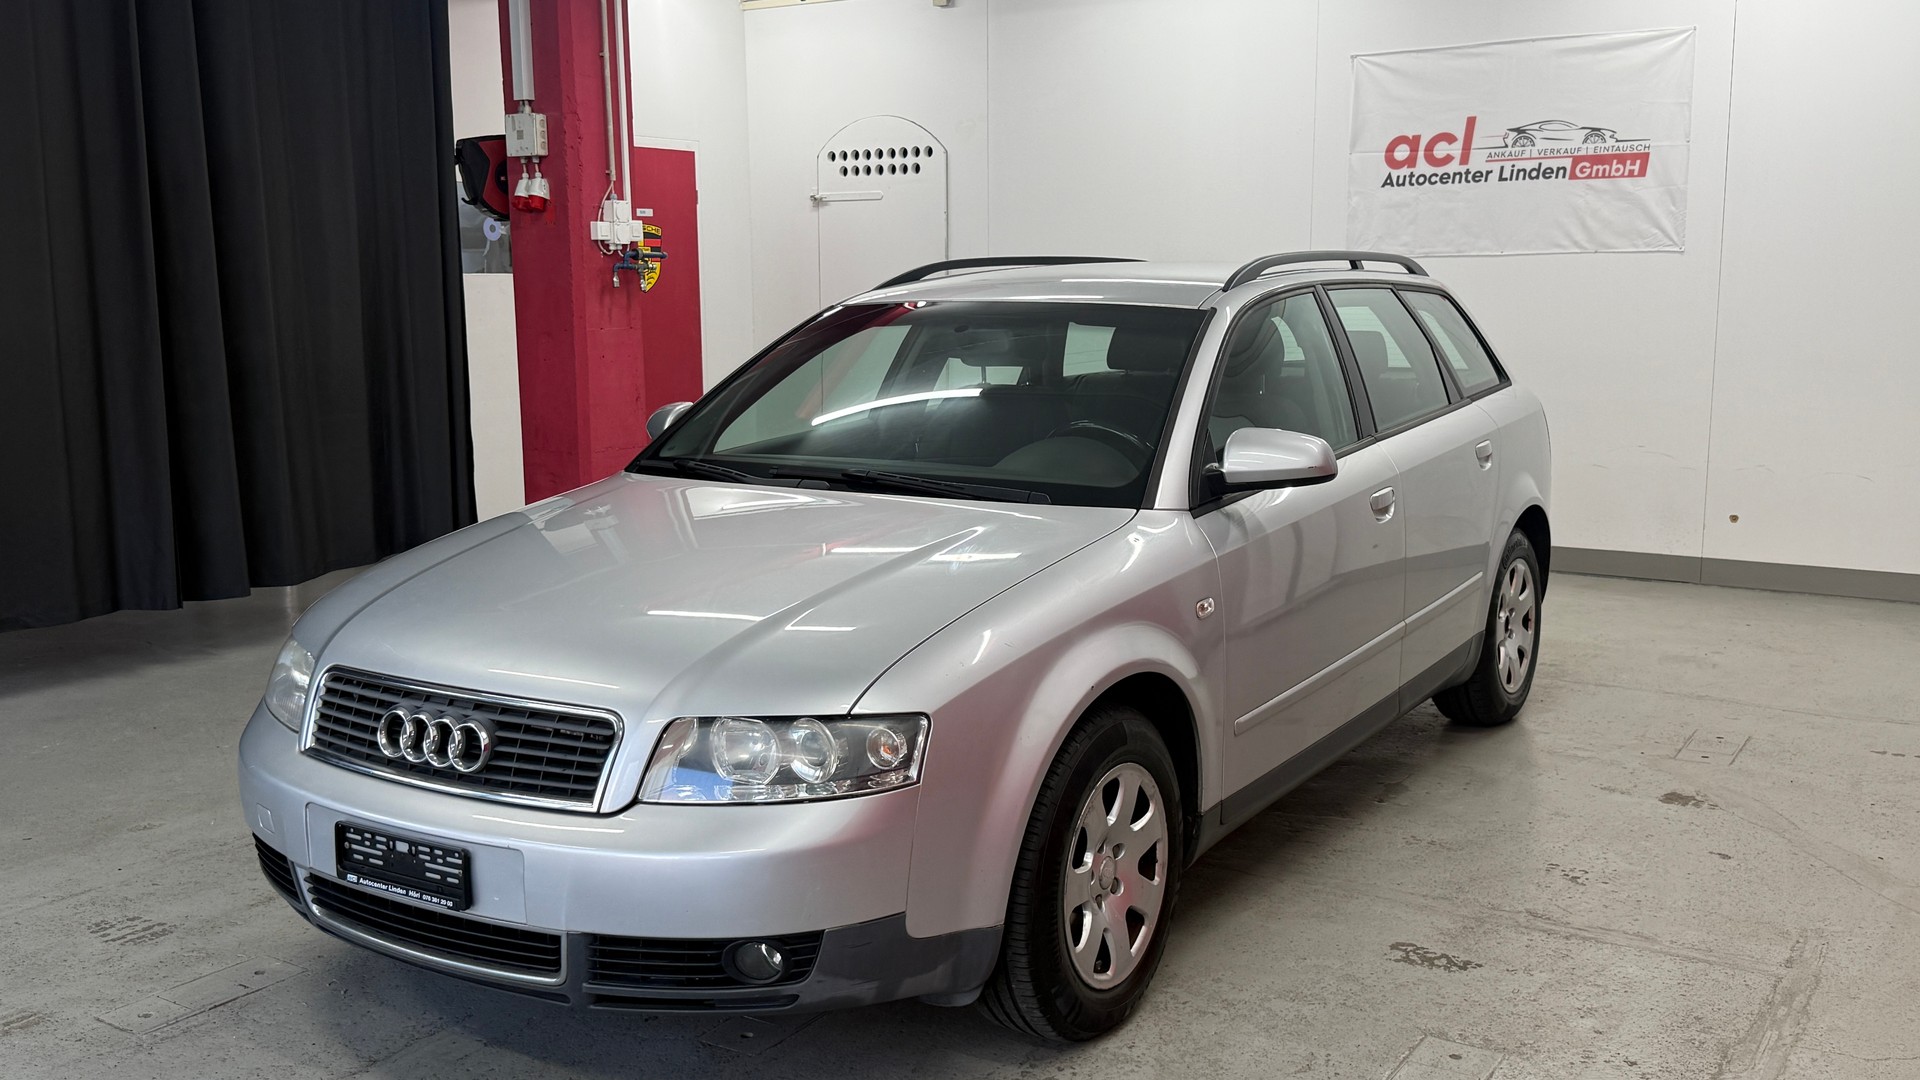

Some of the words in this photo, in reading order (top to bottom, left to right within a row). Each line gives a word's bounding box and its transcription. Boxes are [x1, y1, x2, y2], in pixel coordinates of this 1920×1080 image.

[1383, 115, 1477, 170] acl
[1486, 149, 1527, 159] ANKAUF
[1537, 146, 1582, 156] VERKAUF
[1593, 143, 1651, 153] EINTAUSCH
[1381, 167, 1493, 188] Autocenter
[1497, 162, 1567, 183] Linden
[1574, 159, 1641, 178] GmbH
[642, 225, 661, 235] SCHE
[359, 877, 388, 890] Autocenter
[388, 884, 407, 895] Linden
